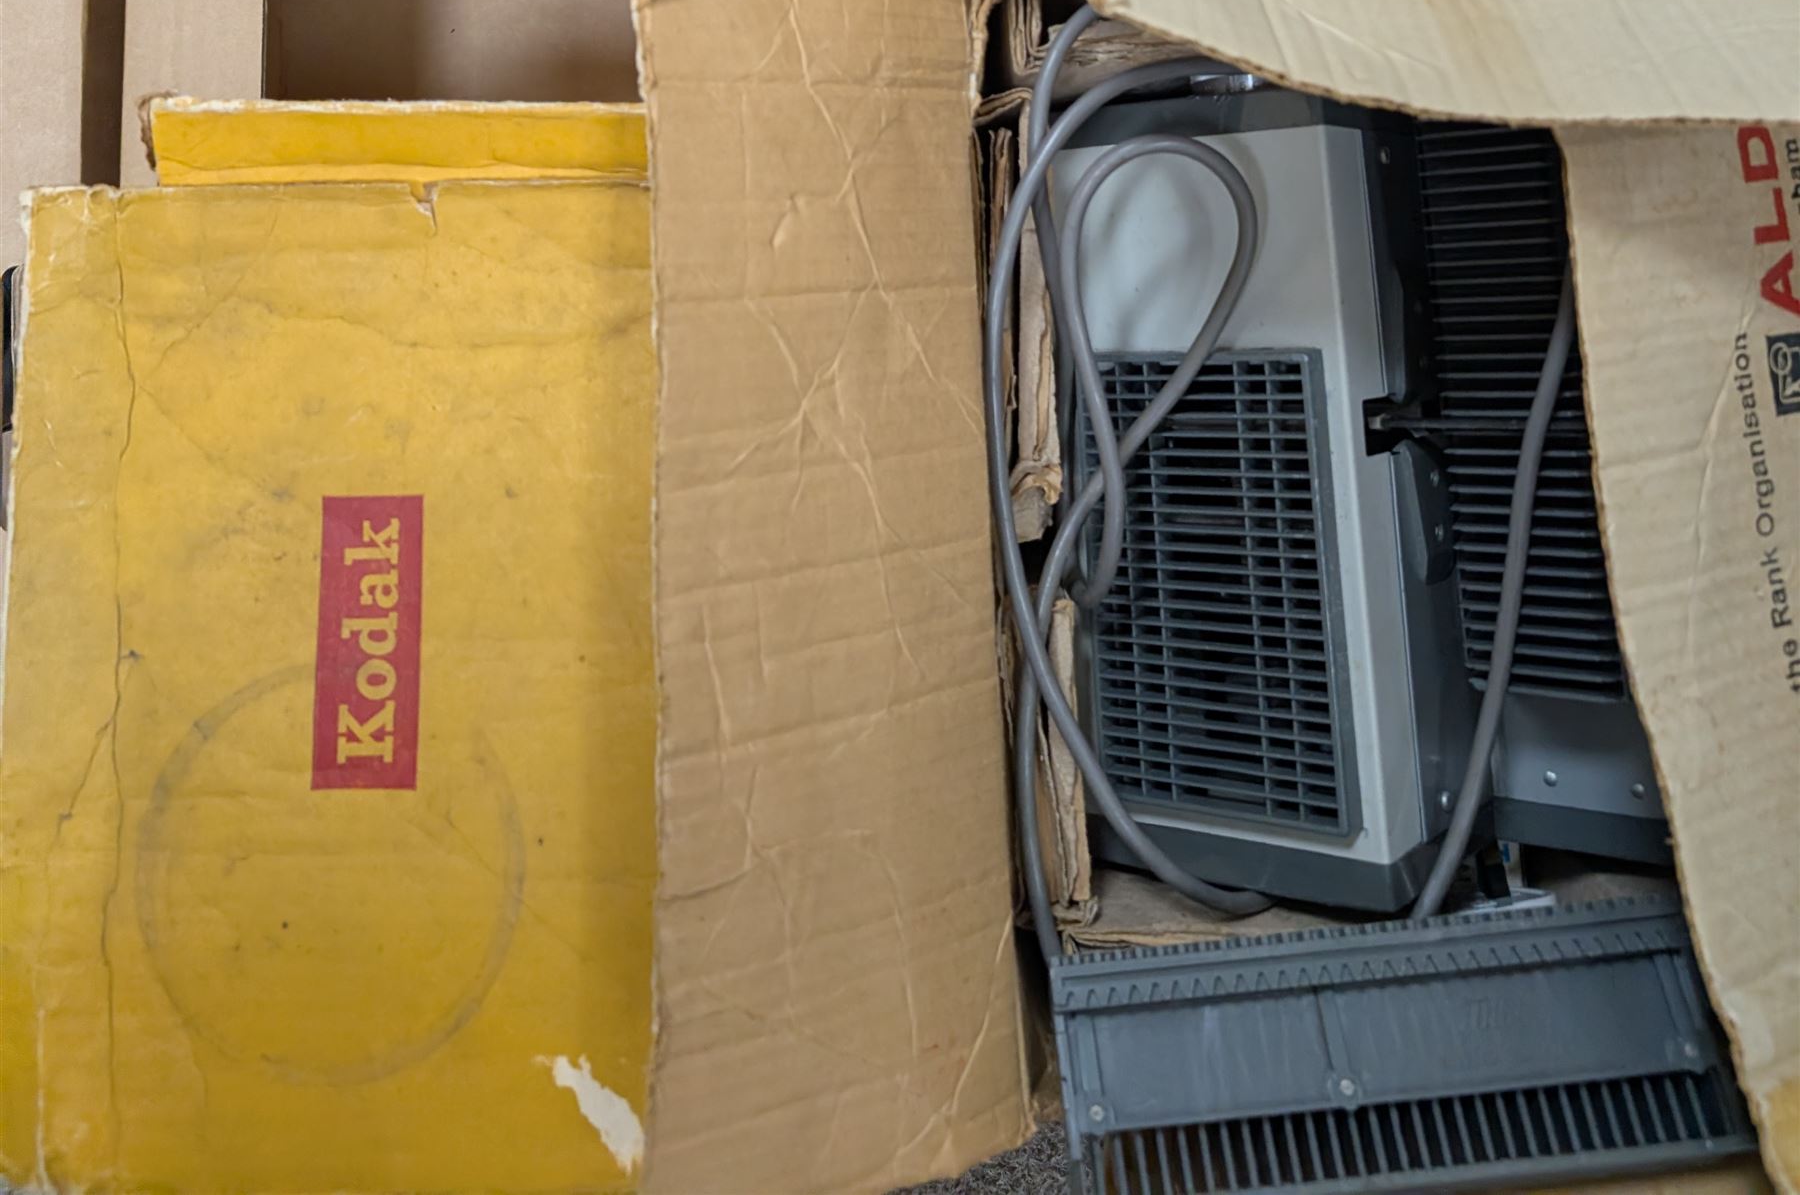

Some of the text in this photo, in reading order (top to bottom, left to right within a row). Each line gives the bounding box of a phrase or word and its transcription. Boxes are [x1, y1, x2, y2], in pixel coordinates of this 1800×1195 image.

[1734, 332, 1775, 537] Organisation
[336, 516, 401, 765] Kodak
[1760, 546, 1792, 630] Rank
